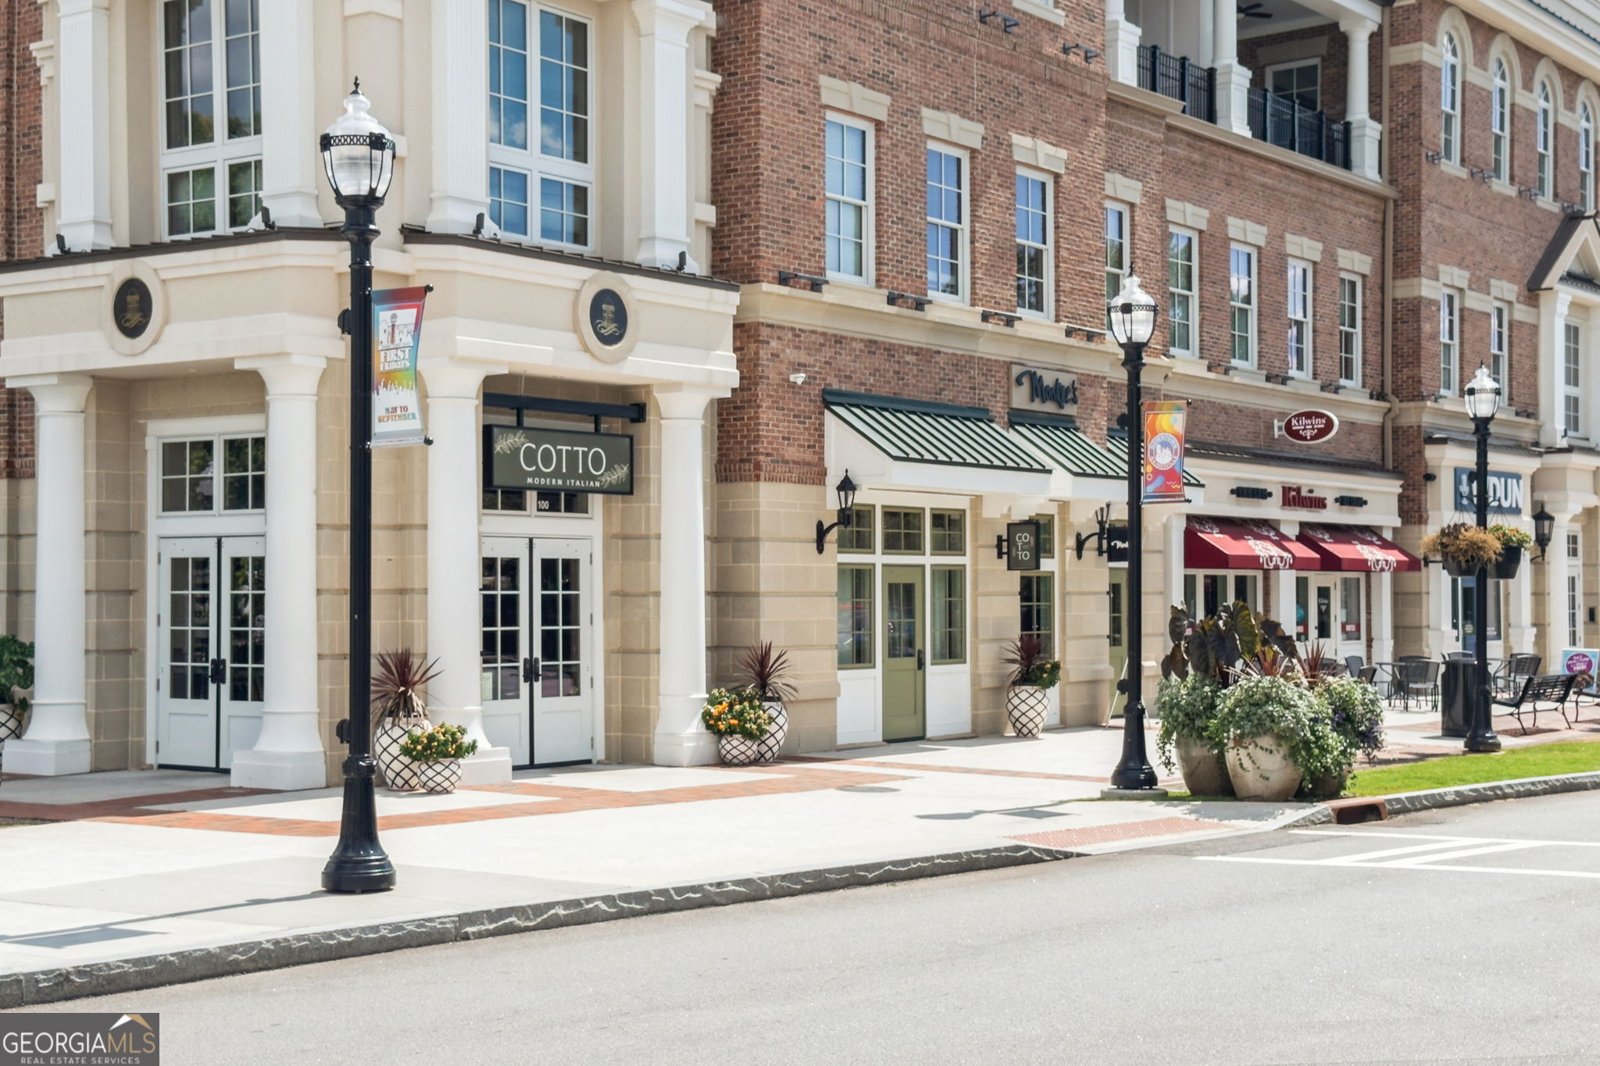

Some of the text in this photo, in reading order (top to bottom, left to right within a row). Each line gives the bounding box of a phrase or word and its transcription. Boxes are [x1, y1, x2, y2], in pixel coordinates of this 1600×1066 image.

[380, 348, 411, 363] FIRST
[385, 405, 409, 414] MAY TO
[377, 412, 417, 423] SEPTEMBER
[1291, 416, 1326, 426] Kilwins
[520, 442, 606, 476] COTTO
[526, 477, 601, 488] MODERN ITALIAN
[1281, 485, 1328, 510] Kilwins
[537, 500, 550, 510] 100
[1015, 532, 1030, 543] CO
[1016, 542, 1023, 551] T
[1016, 551, 1030, 560] TO
